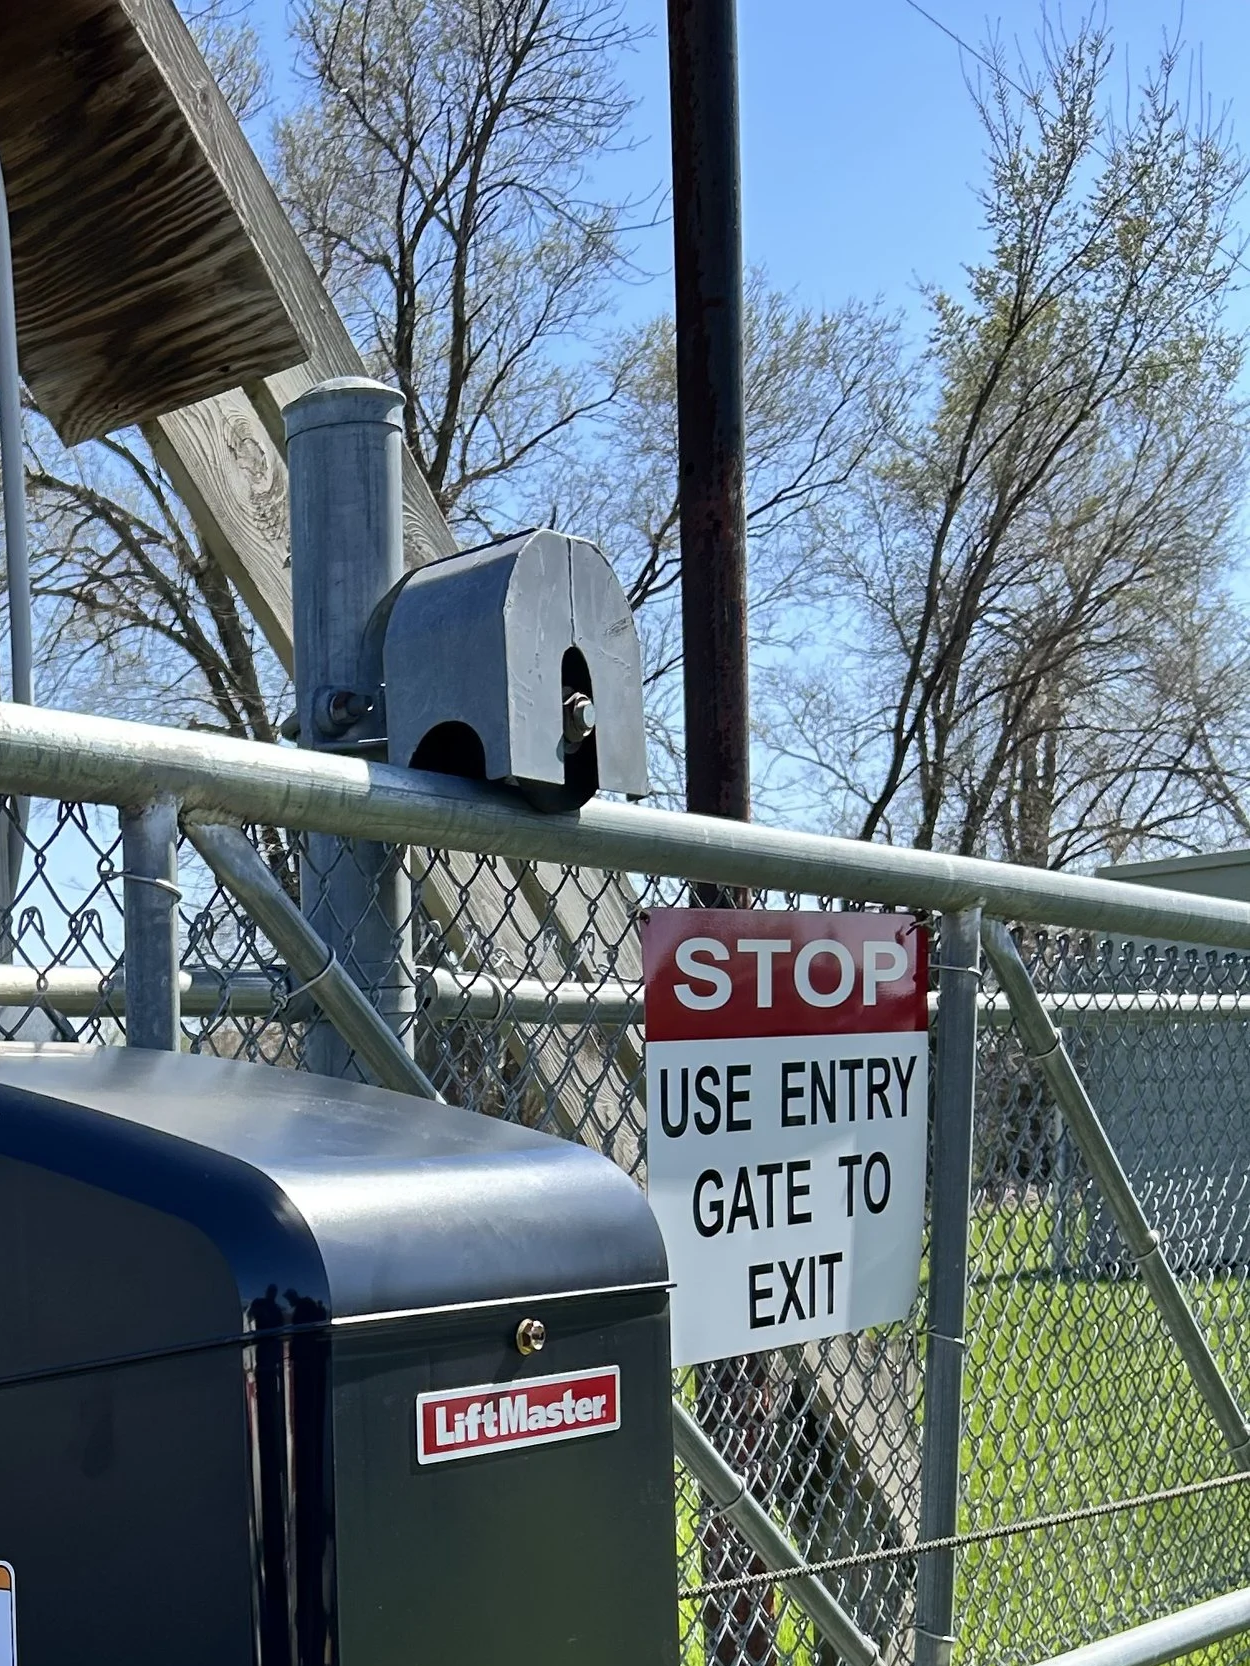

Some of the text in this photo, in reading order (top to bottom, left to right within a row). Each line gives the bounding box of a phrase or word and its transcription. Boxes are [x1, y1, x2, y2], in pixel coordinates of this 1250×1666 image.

[673, 937, 909, 1011] STOP
[660, 1055, 917, 1138] USE ENTRY
[693, 1151, 892, 1238] GATE TO
[749, 1252, 843, 1329] EXIT
[435, 1389, 607, 1447] LiftMaster
